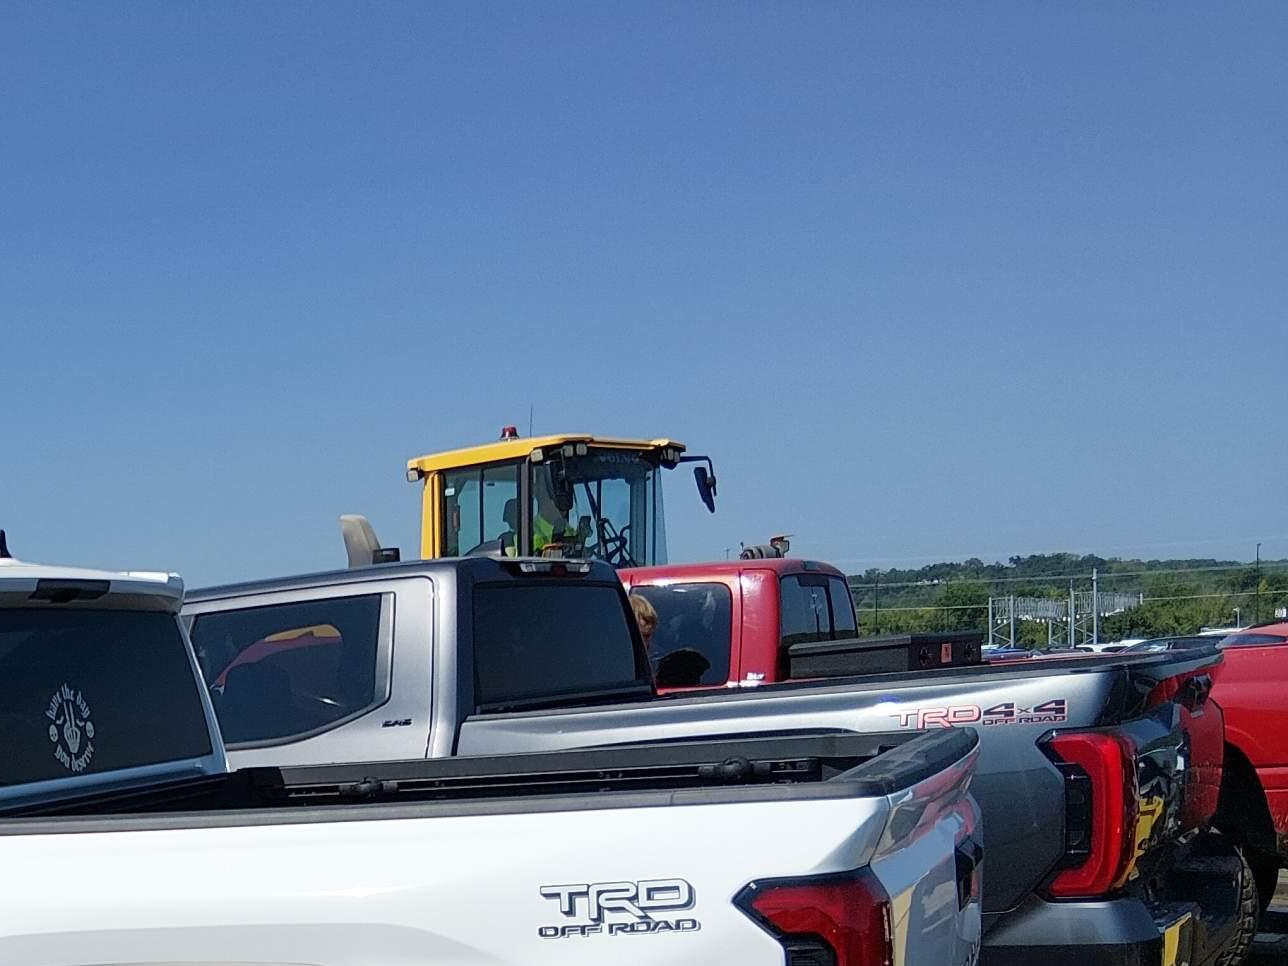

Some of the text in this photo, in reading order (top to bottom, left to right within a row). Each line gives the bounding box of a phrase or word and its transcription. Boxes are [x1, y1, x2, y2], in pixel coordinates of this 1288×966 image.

[45, 683, 91, 720] have the day
[889, 704, 982, 729] TRD
[983, 715, 1066, 725] OFF ROAD
[54, 744, 70, 768] you
[540, 878, 697, 923] TRD
[538, 918, 702, 938] OFF ROAD
